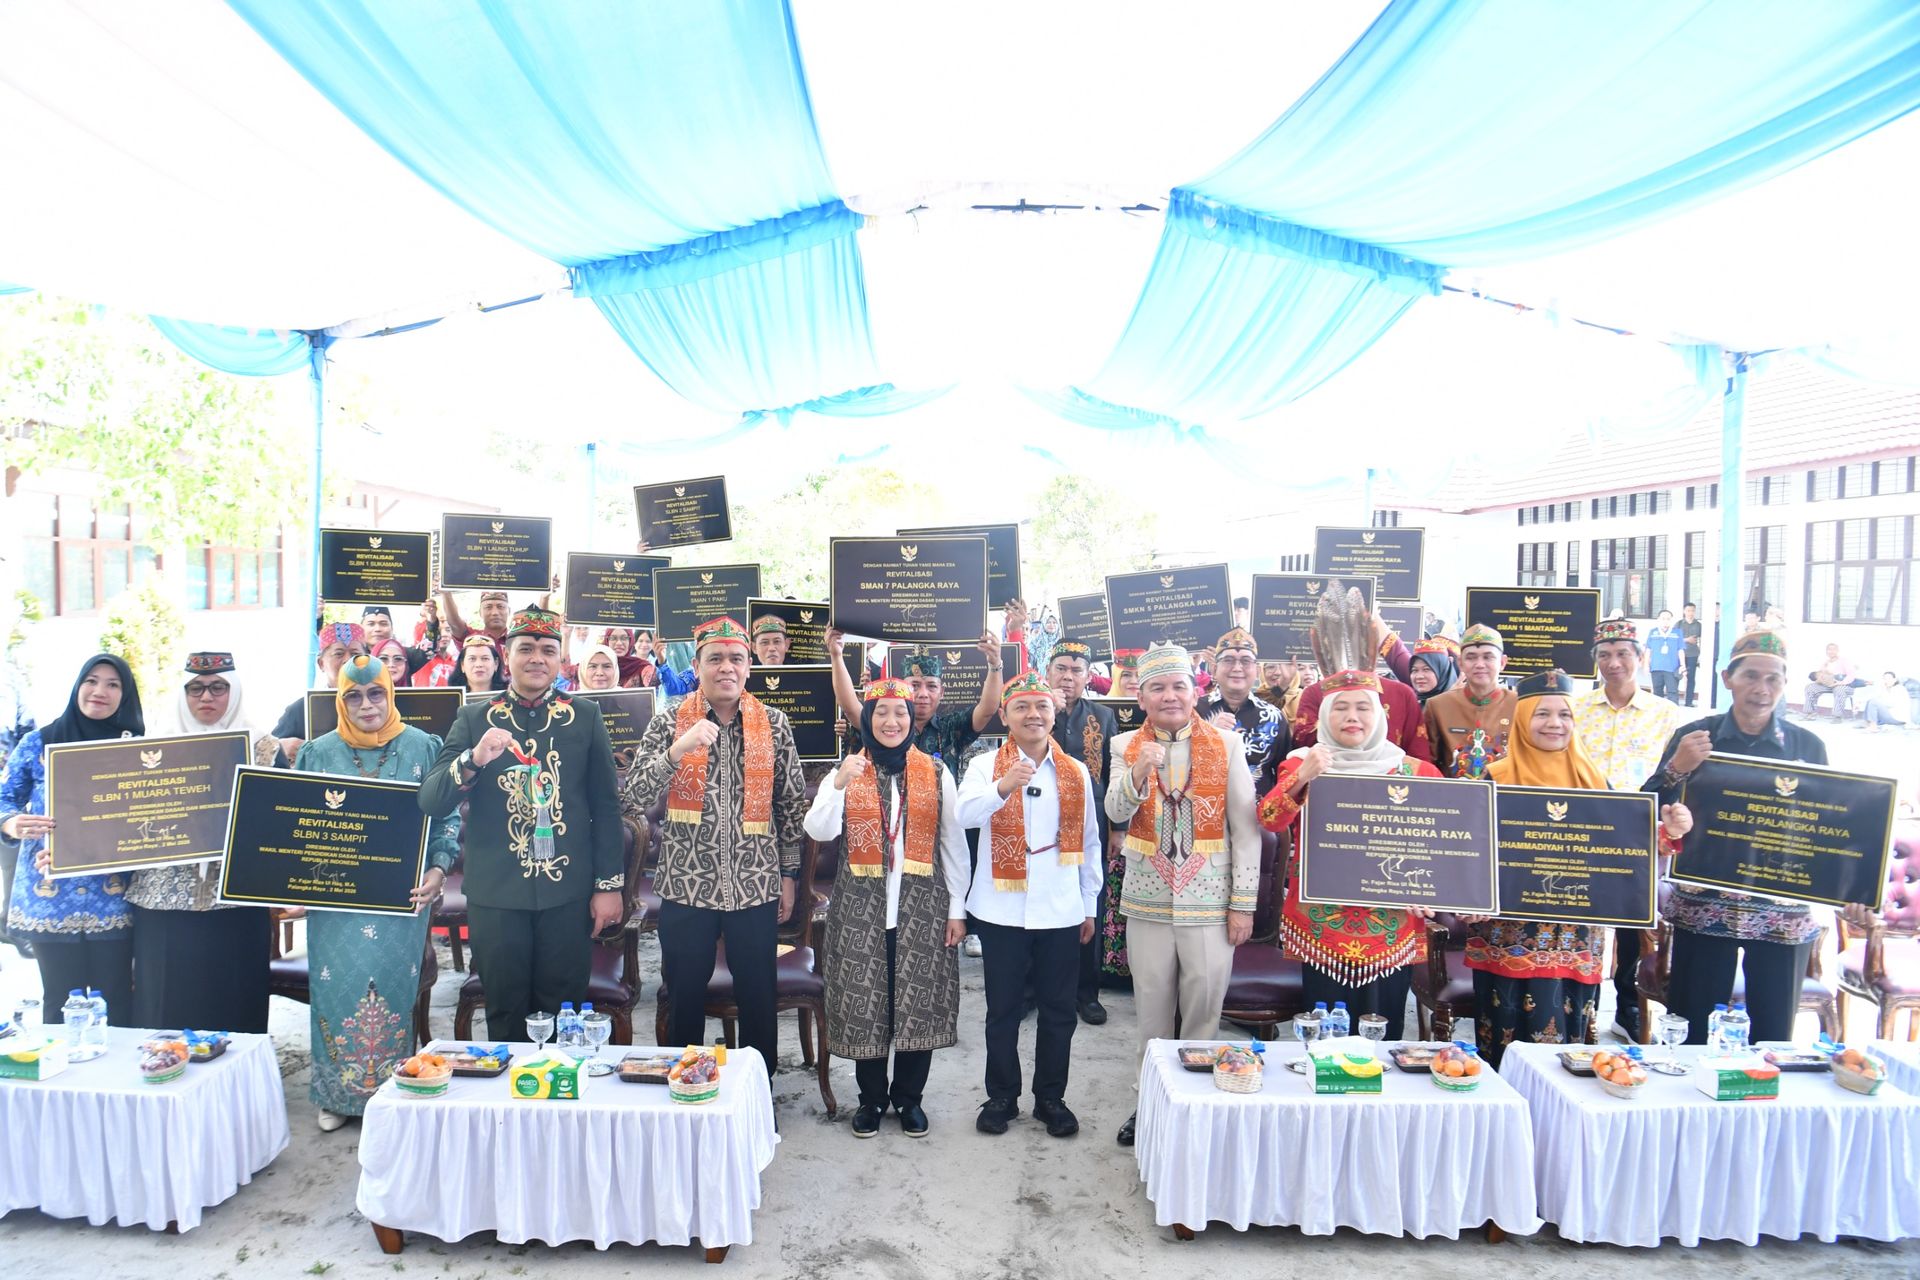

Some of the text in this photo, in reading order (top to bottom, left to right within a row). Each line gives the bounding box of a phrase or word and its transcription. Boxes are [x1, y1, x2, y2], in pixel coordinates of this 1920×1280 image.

[1145, 593, 1193, 603] REVITALISASI
[1123, 606, 1145, 614] SMKN
[1154, 601, 1195, 611] PALANGKA
[1197, 598, 1216, 607] RAYA
[118, 776, 186, 790] REVITALISASI
[93, 784, 211, 803] SLBN 1 MUARA TEWEH
[1362, 813, 1435, 825] REVITALISASI
[1747, 803, 1819, 821] REVITALISASI
[298, 817, 364, 831] REVITALISASI
[1326, 823, 1472, 840] SMKN 2 PALANGKA RAYA
[1717, 811, 1850, 838] SLBN 2 PALANGKA RAYA
[293, 829, 368, 844] SLBN 3 SAMPIT
[1524, 831, 1590, 842] REVITALISASI
[1498, 841, 1564, 852] UHAMMADIYAH
[1573, 845, 1622, 855] PALANGKA
[1624, 848, 1648, 857] RAYA
